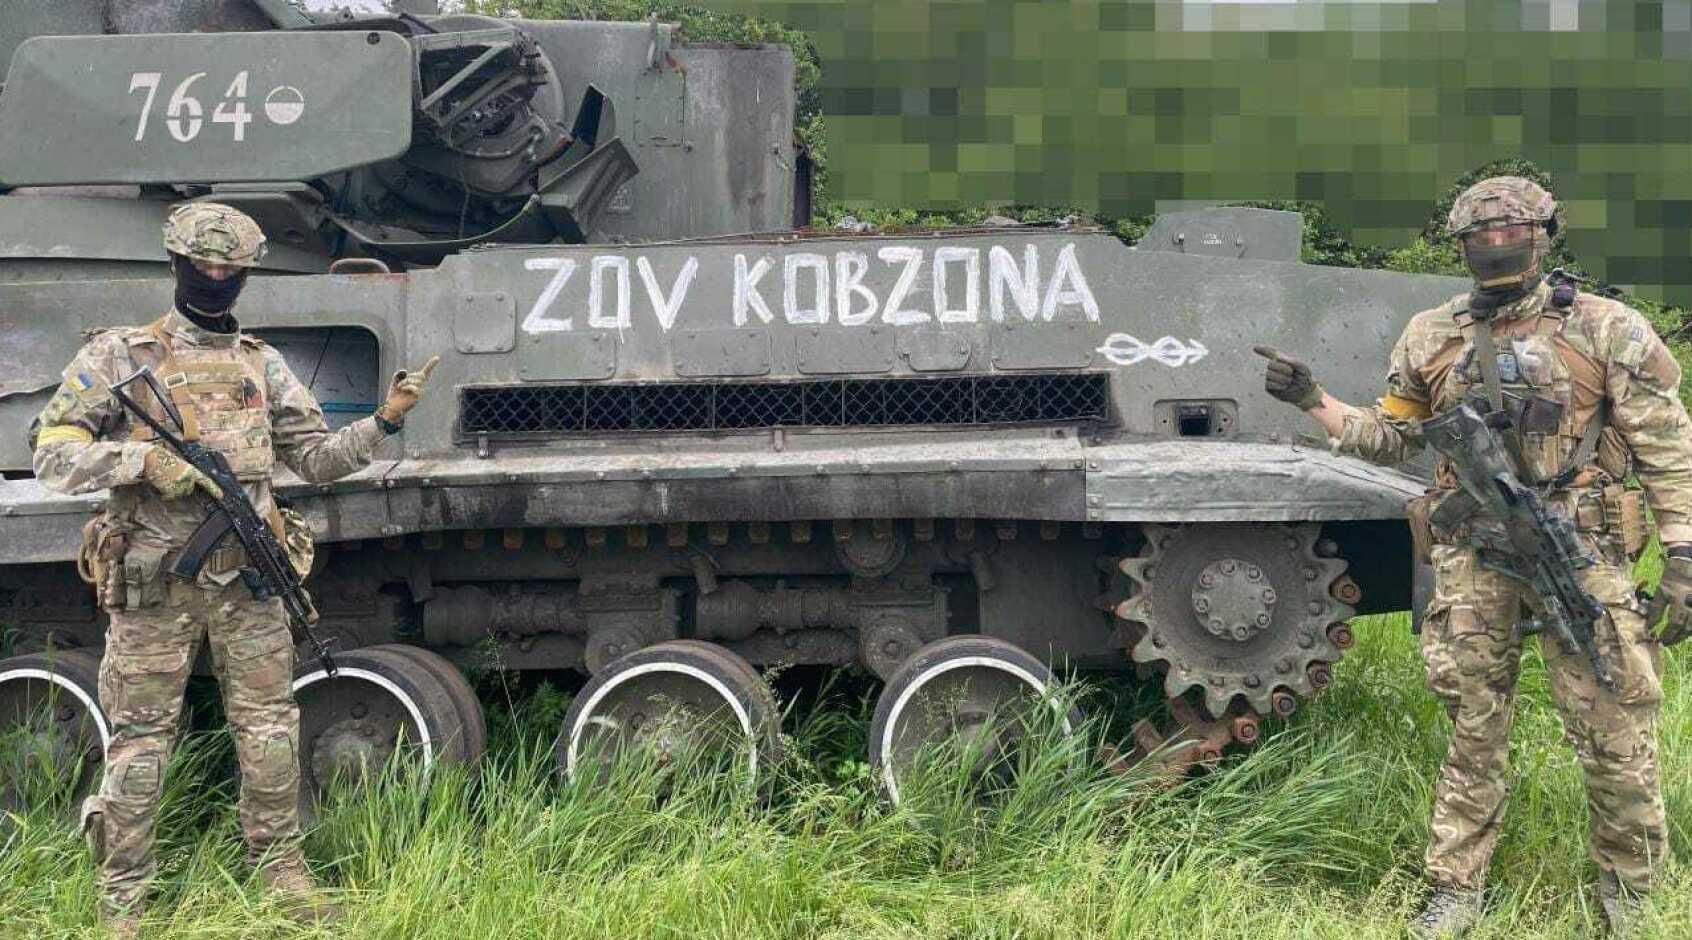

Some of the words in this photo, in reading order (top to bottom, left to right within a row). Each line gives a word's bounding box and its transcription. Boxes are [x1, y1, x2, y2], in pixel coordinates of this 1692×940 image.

[128, 70, 252, 142] 764
[521, 255, 699, 334] ZOV
[732, 243, 1100, 327] KOBZONA
